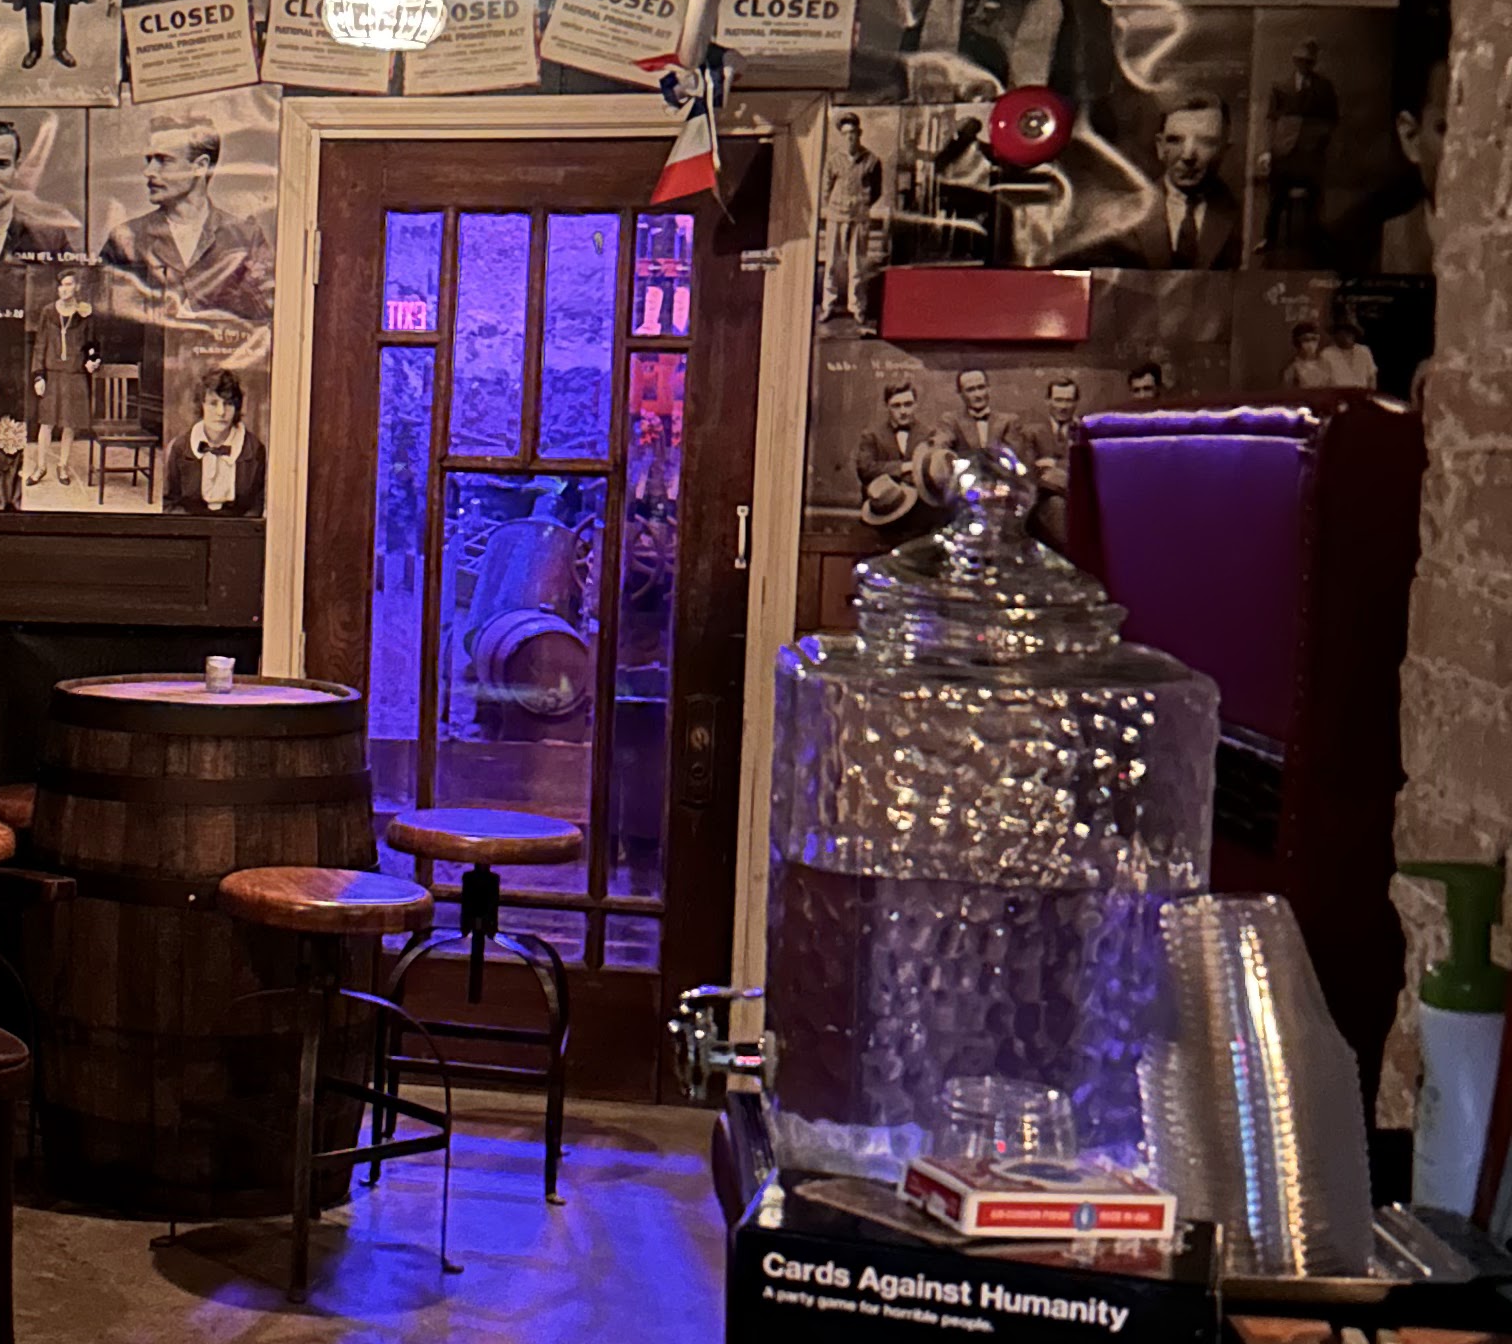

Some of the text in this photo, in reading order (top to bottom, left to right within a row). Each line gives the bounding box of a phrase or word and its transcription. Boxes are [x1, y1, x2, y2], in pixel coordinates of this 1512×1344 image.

[139, 3, 235, 34] CLOSED
[762, 1251, 1130, 1333] Cards Against Humanity
[762, 1285, 774, 1299] A
[777, 1286, 814, 1307] party
[817, 1296, 858, 1312] game
[859, 1300, 881, 1315] for
[883, 1305, 939, 1325] horrible
